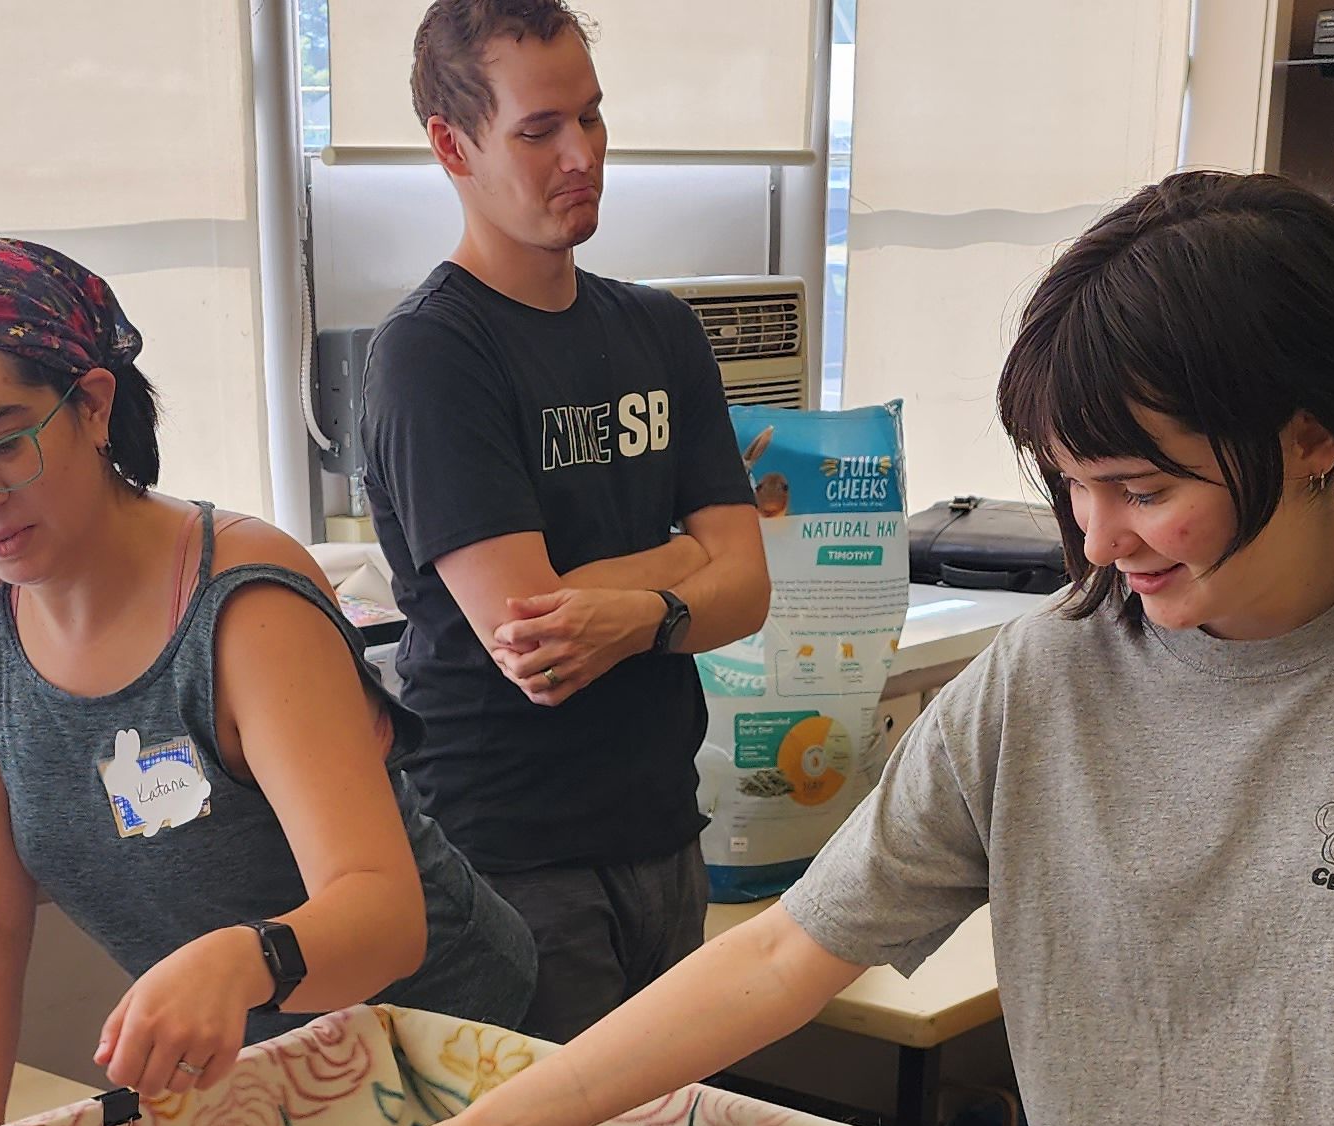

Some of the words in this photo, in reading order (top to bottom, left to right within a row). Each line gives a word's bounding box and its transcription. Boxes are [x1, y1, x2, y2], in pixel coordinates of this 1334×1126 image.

[542, 402, 612, 471] NIKE
[618, 389, 670, 457] SB
[839, 456, 880, 478] FULL
[826, 478, 889, 501] CHEEKS
[802, 521, 870, 539] NATURAL
[877, 520, 899, 538] HAY
[827, 550, 875, 560] TIMOTHY
